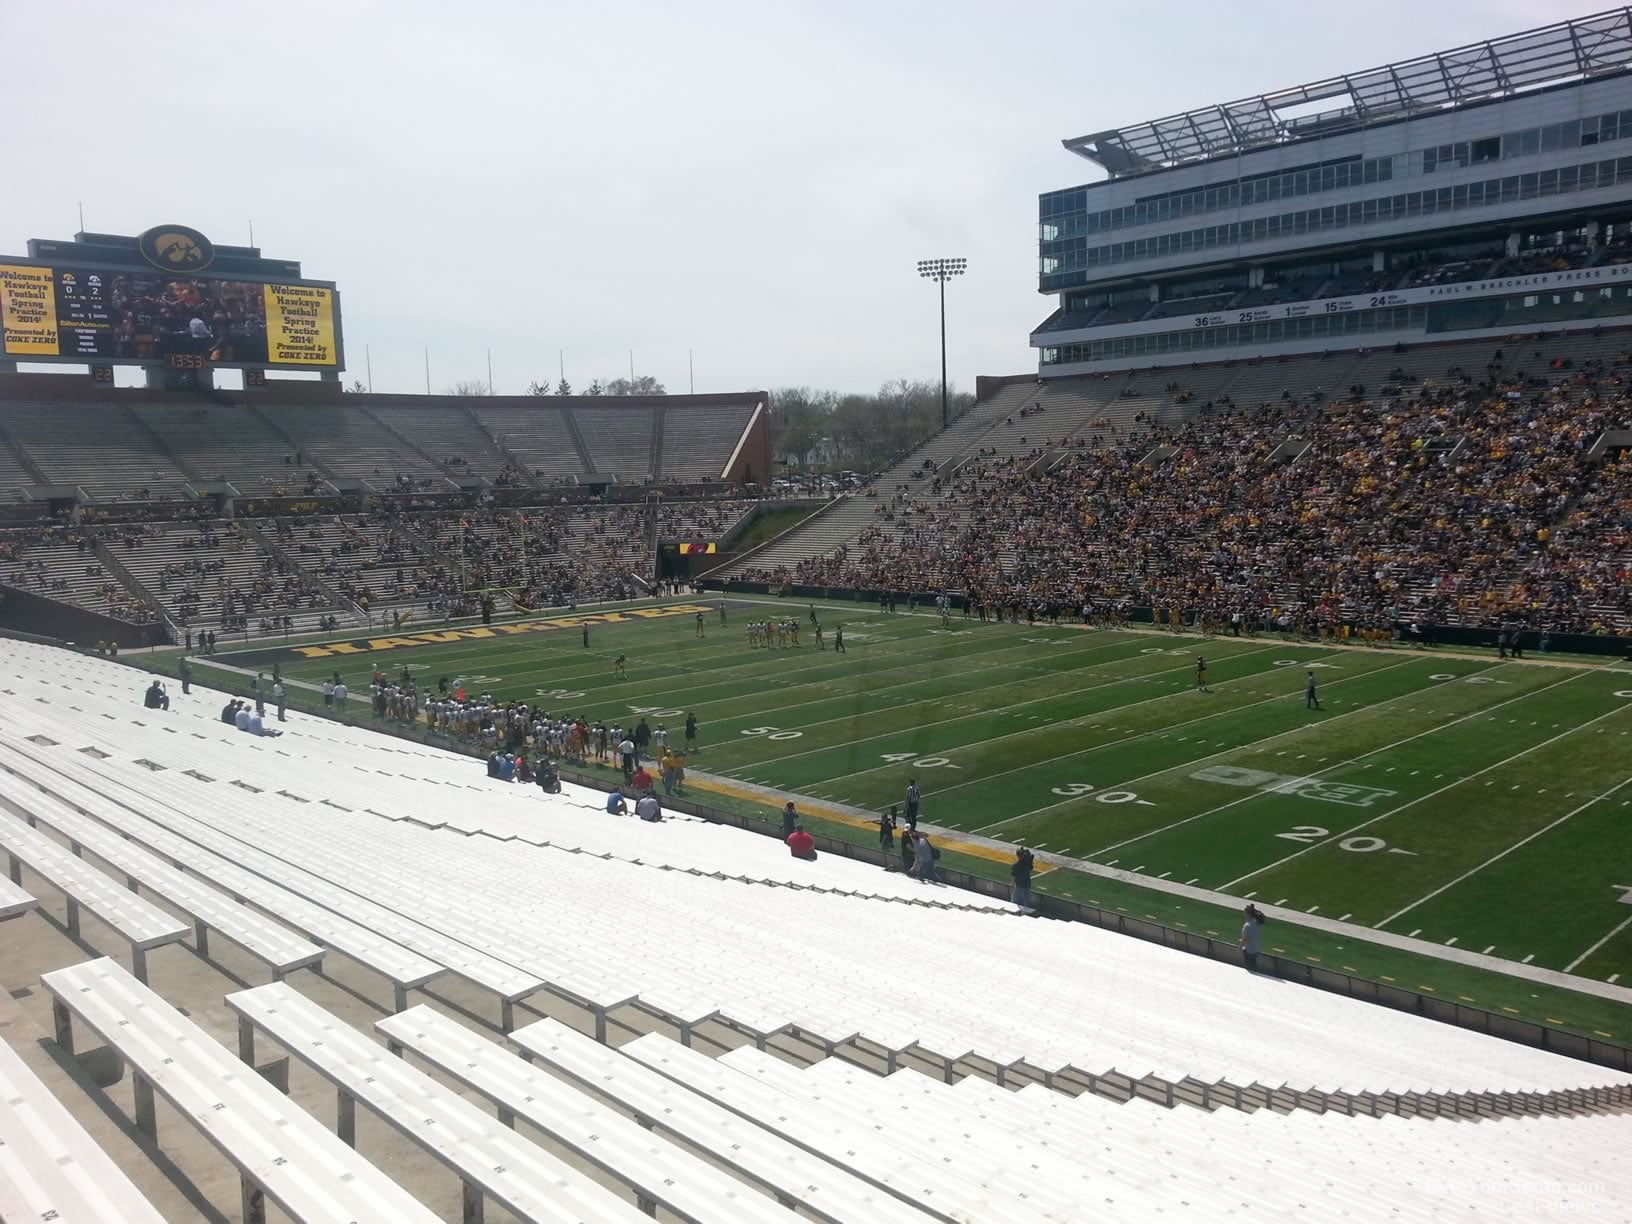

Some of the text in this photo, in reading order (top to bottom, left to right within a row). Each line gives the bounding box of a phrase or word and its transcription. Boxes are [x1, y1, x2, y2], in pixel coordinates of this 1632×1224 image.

[0, 271, 53, 282] Welcome to
[4, 281, 48, 292] Hawkeye
[1429, 287, 1460, 296] PAUL
[1481, 276, 1549, 290] BRECHLER
[1557, 270, 1601, 281] PRESS
[8, 290, 46, 300] Football
[66, 286, 73, 294] 0
[92, 287, 99, 295] 2
[270, 285, 326, 298] Welcome to
[11, 299, 44, 309] Spring
[276, 296, 320, 308] Hawkeye
[1370, 296, 1386, 307] 24
[9, 307, 47, 316] Practice
[280, 306, 318, 317] Football
[1286, 307, 1291, 317] 1
[1325, 302, 1337, 312] 15
[284, 316, 316, 327] Spring
[1195, 317, 1208, 327] 36
[1239, 312, 1253, 322] 25
[4, 328, 57, 338] Presented by
[282, 326, 319, 336] Practice
[6, 336, 57, 344] COKE ZERO
[289, 335, 314, 344] 2014!
[276, 343, 327, 353] Presented by
[278, 352, 327, 361] COKE ZERO
[95, 369, 112, 381] 22
[292, 605, 715, 658] HAWKEYES
[740, 725, 803, 741] 50
[879, 751, 950, 769] 40
[1051, 782, 1138, 804] 30
[1274, 825, 1387, 854] 20
